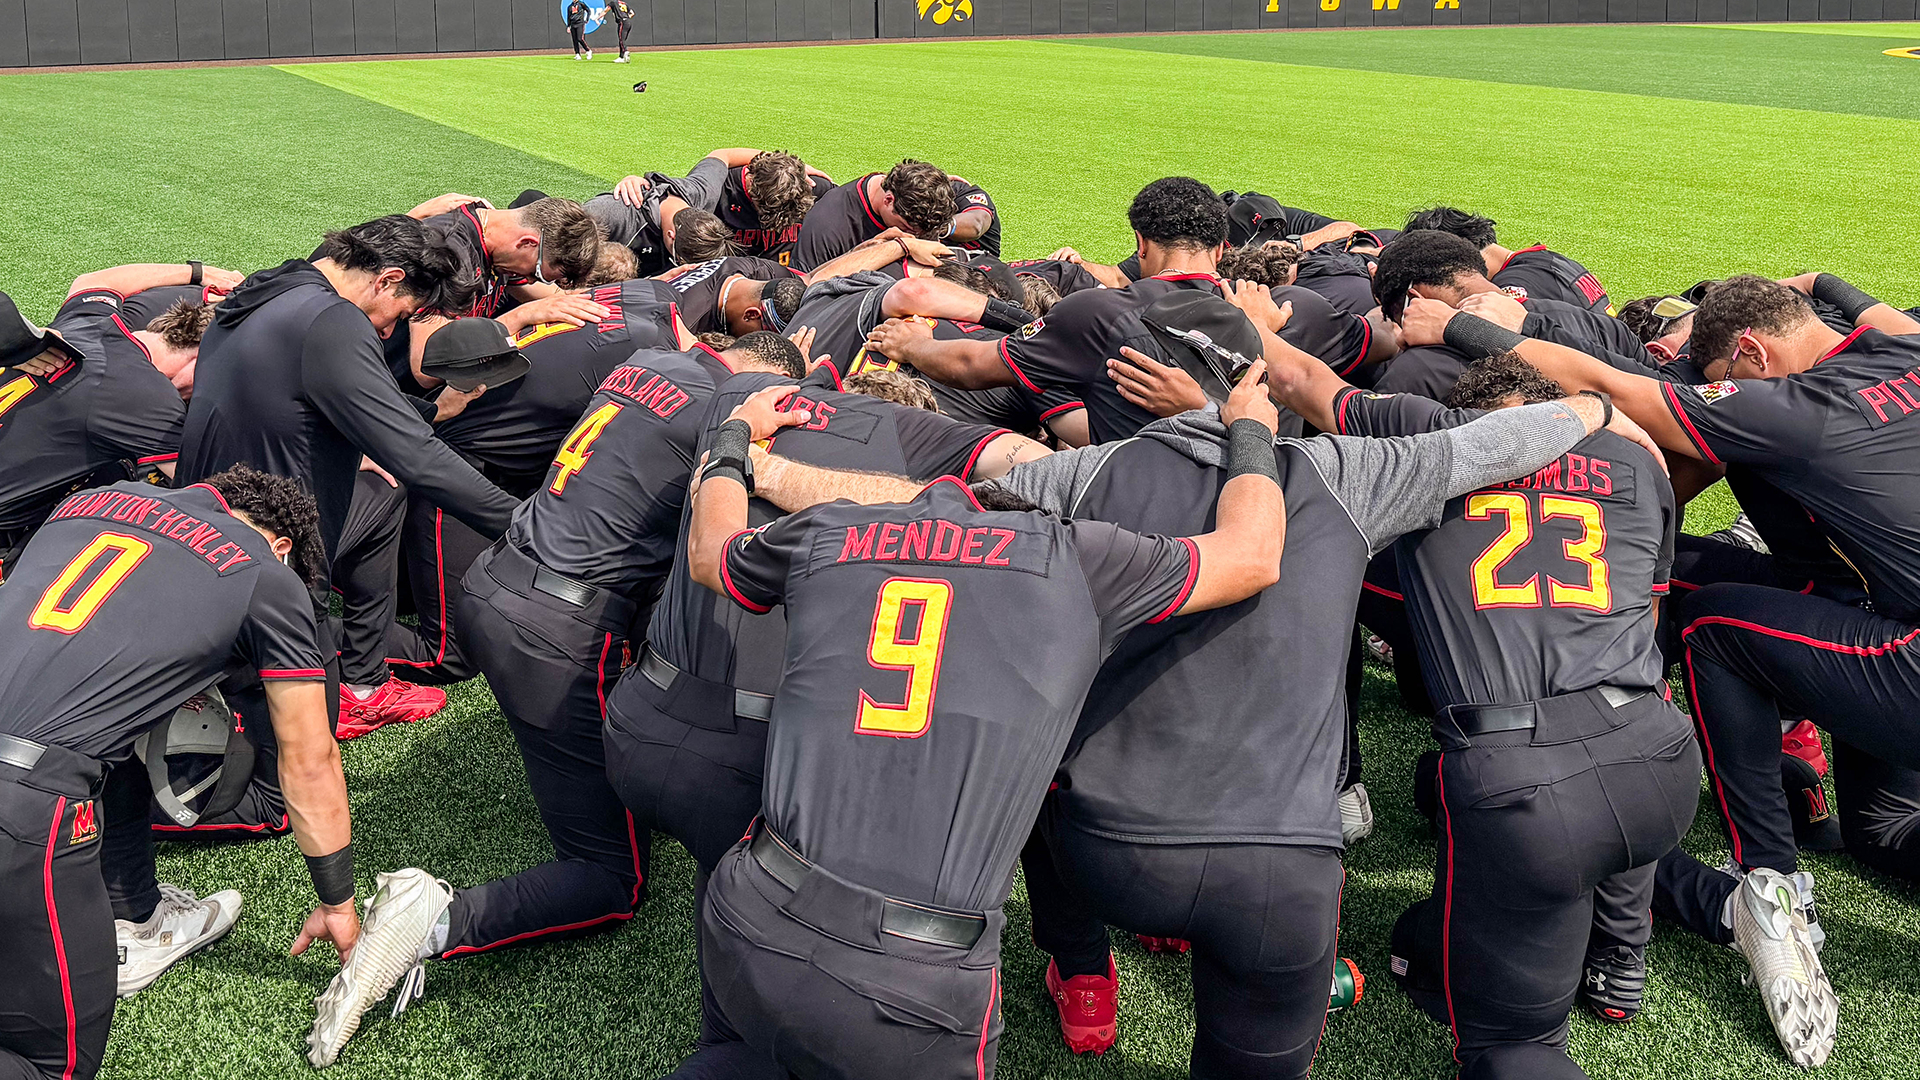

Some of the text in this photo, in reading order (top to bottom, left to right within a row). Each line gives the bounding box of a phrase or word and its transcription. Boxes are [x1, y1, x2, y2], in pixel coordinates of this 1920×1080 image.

[548, 400, 625, 496] 4
[50, 490, 252, 573] HAWTON-HENLEY
[837, 519, 1017, 567] MENDEZ
[1465, 491, 1614, 615] 23
[27, 530, 154, 636] 0
[853, 576, 955, 739] 9
[71, 799, 98, 840] M
